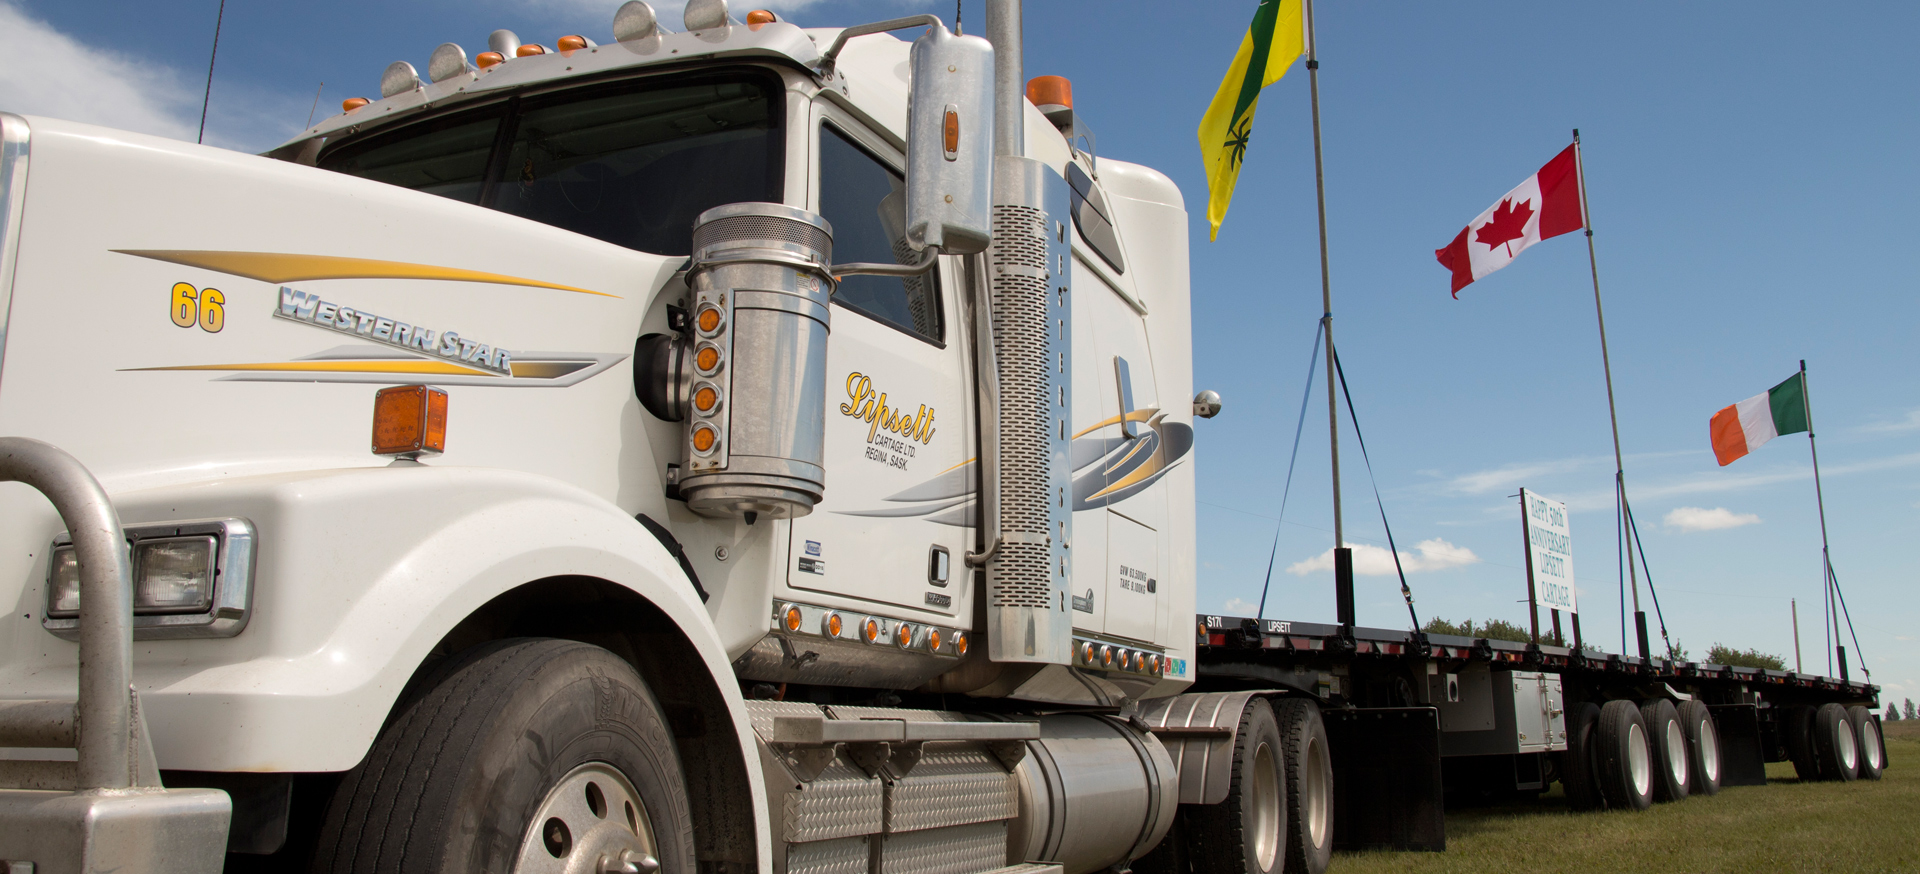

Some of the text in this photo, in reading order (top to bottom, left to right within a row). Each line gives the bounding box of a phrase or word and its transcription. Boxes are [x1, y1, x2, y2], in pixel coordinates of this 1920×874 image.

[170, 281, 226, 333] 66
[840, 371, 936, 445] Lipsett
[1055, 219, 1065, 613] WESTERN STAR
[874, 434, 916, 459] CARTAGE LTD.
[889, 454, 909, 471] SASK.
[1530, 495, 1564, 528] HAPPY 50th
[1530, 523, 1570, 556] ANNIVERSARY
[1119, 564, 1129, 577] GVW
[1539, 551, 1565, 579] LIPSETT
[1119, 577, 1130, 590] TARE
[1541, 580, 1571, 607] CARTAGE
[1267, 620, 1292, 633] LIPSETT
[614, 685, 697, 869] MICHELIN
